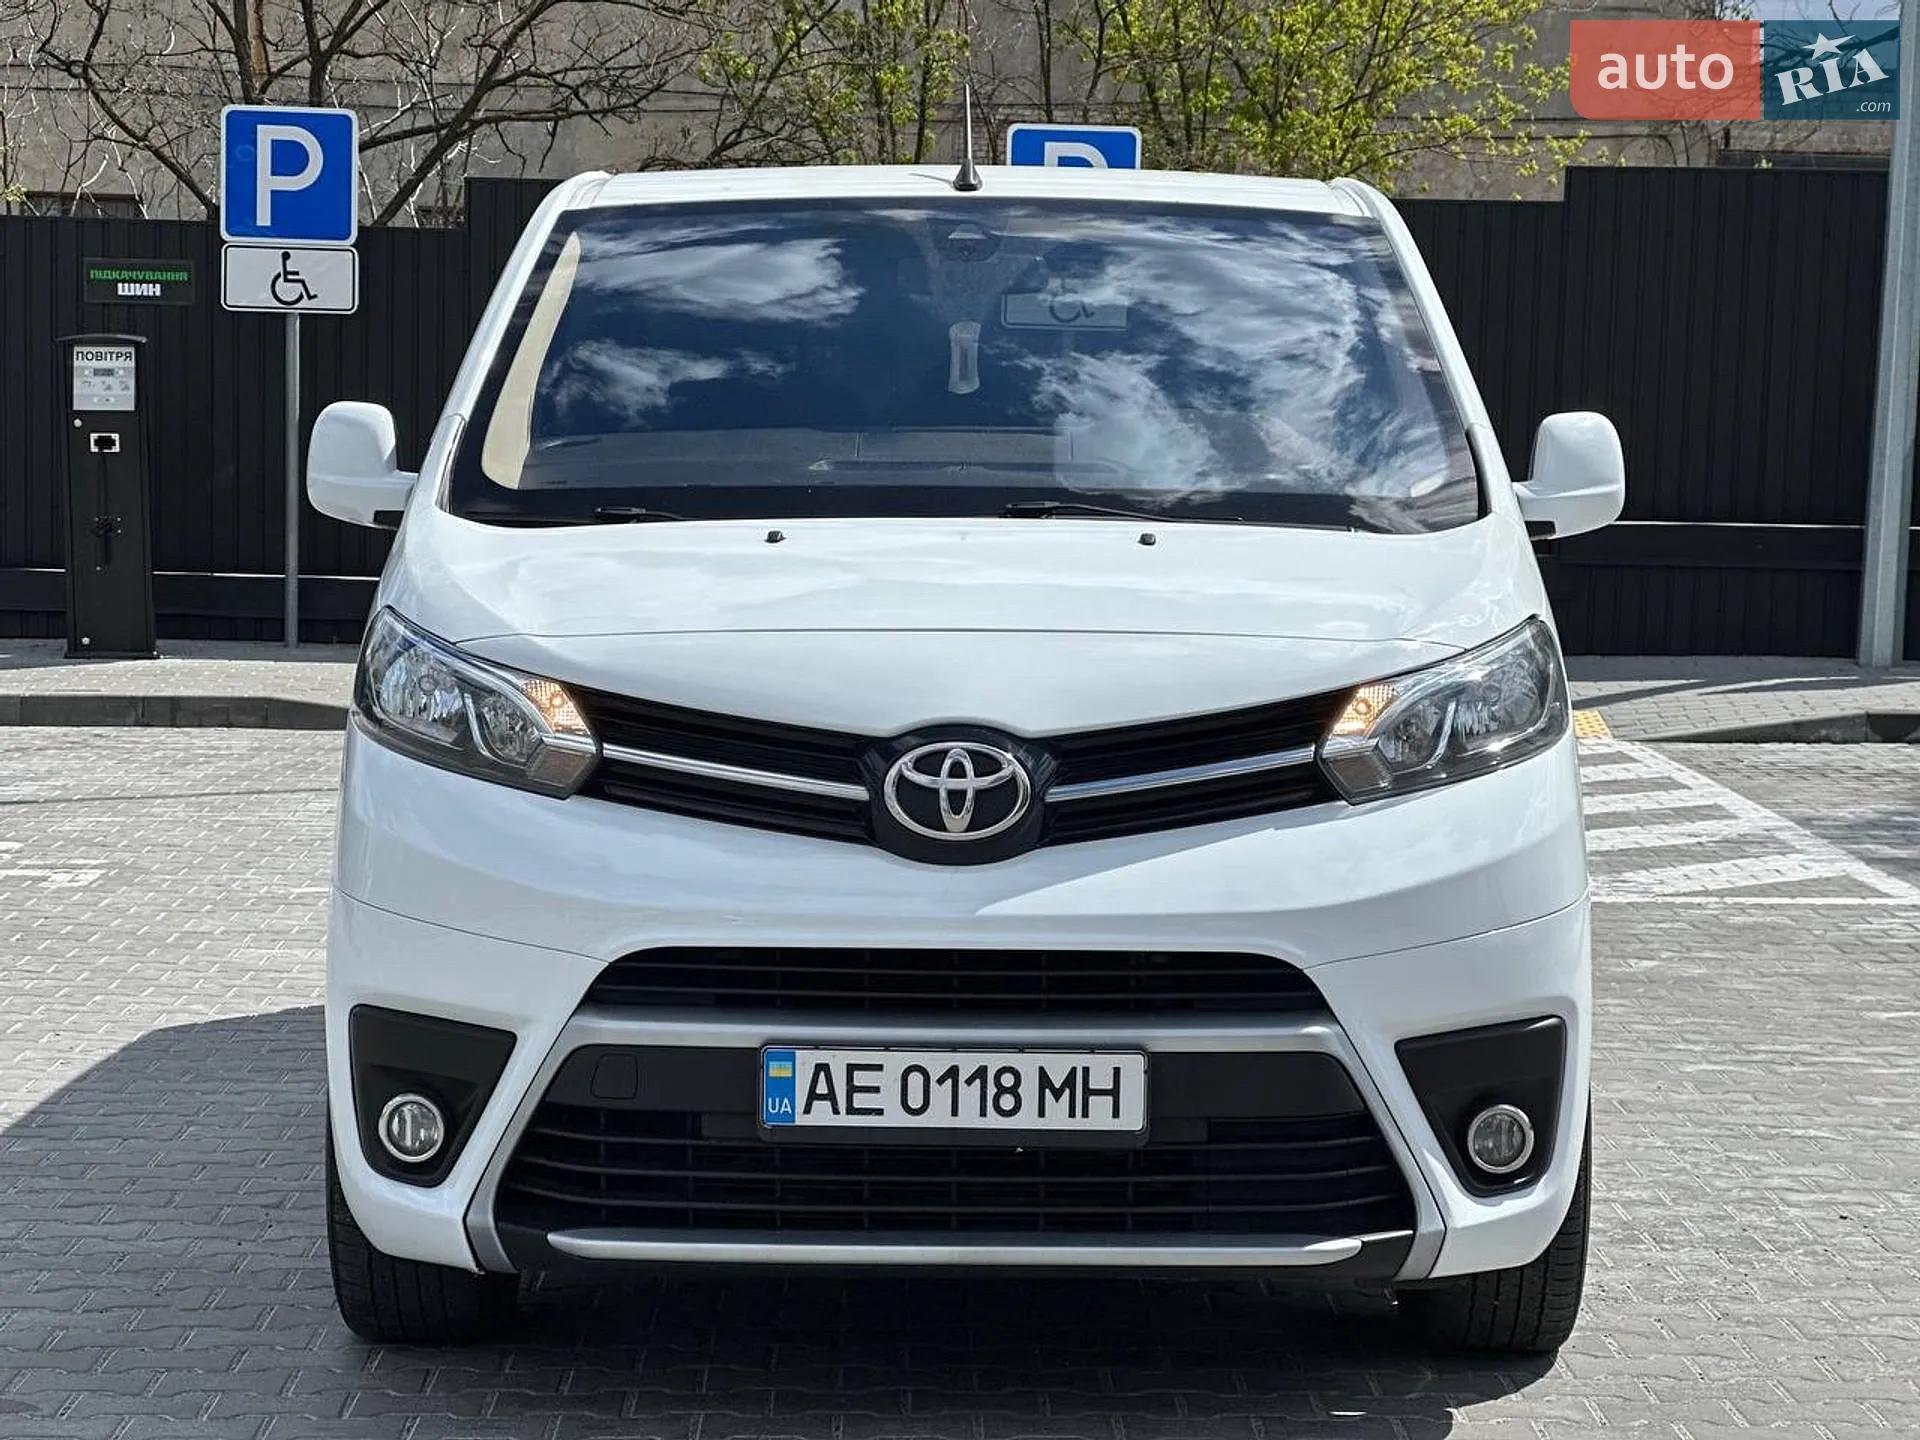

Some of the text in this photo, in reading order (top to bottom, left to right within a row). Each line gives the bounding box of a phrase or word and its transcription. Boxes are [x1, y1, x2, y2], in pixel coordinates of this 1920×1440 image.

[256, 124, 324, 227] P
[117, 282, 161, 297] ШИН
[75, 350, 133, 362] ПОВІТРЯ
[802, 1062, 1121, 1119] AE 0118 MH
[768, 1097, 792, 1114] UA
